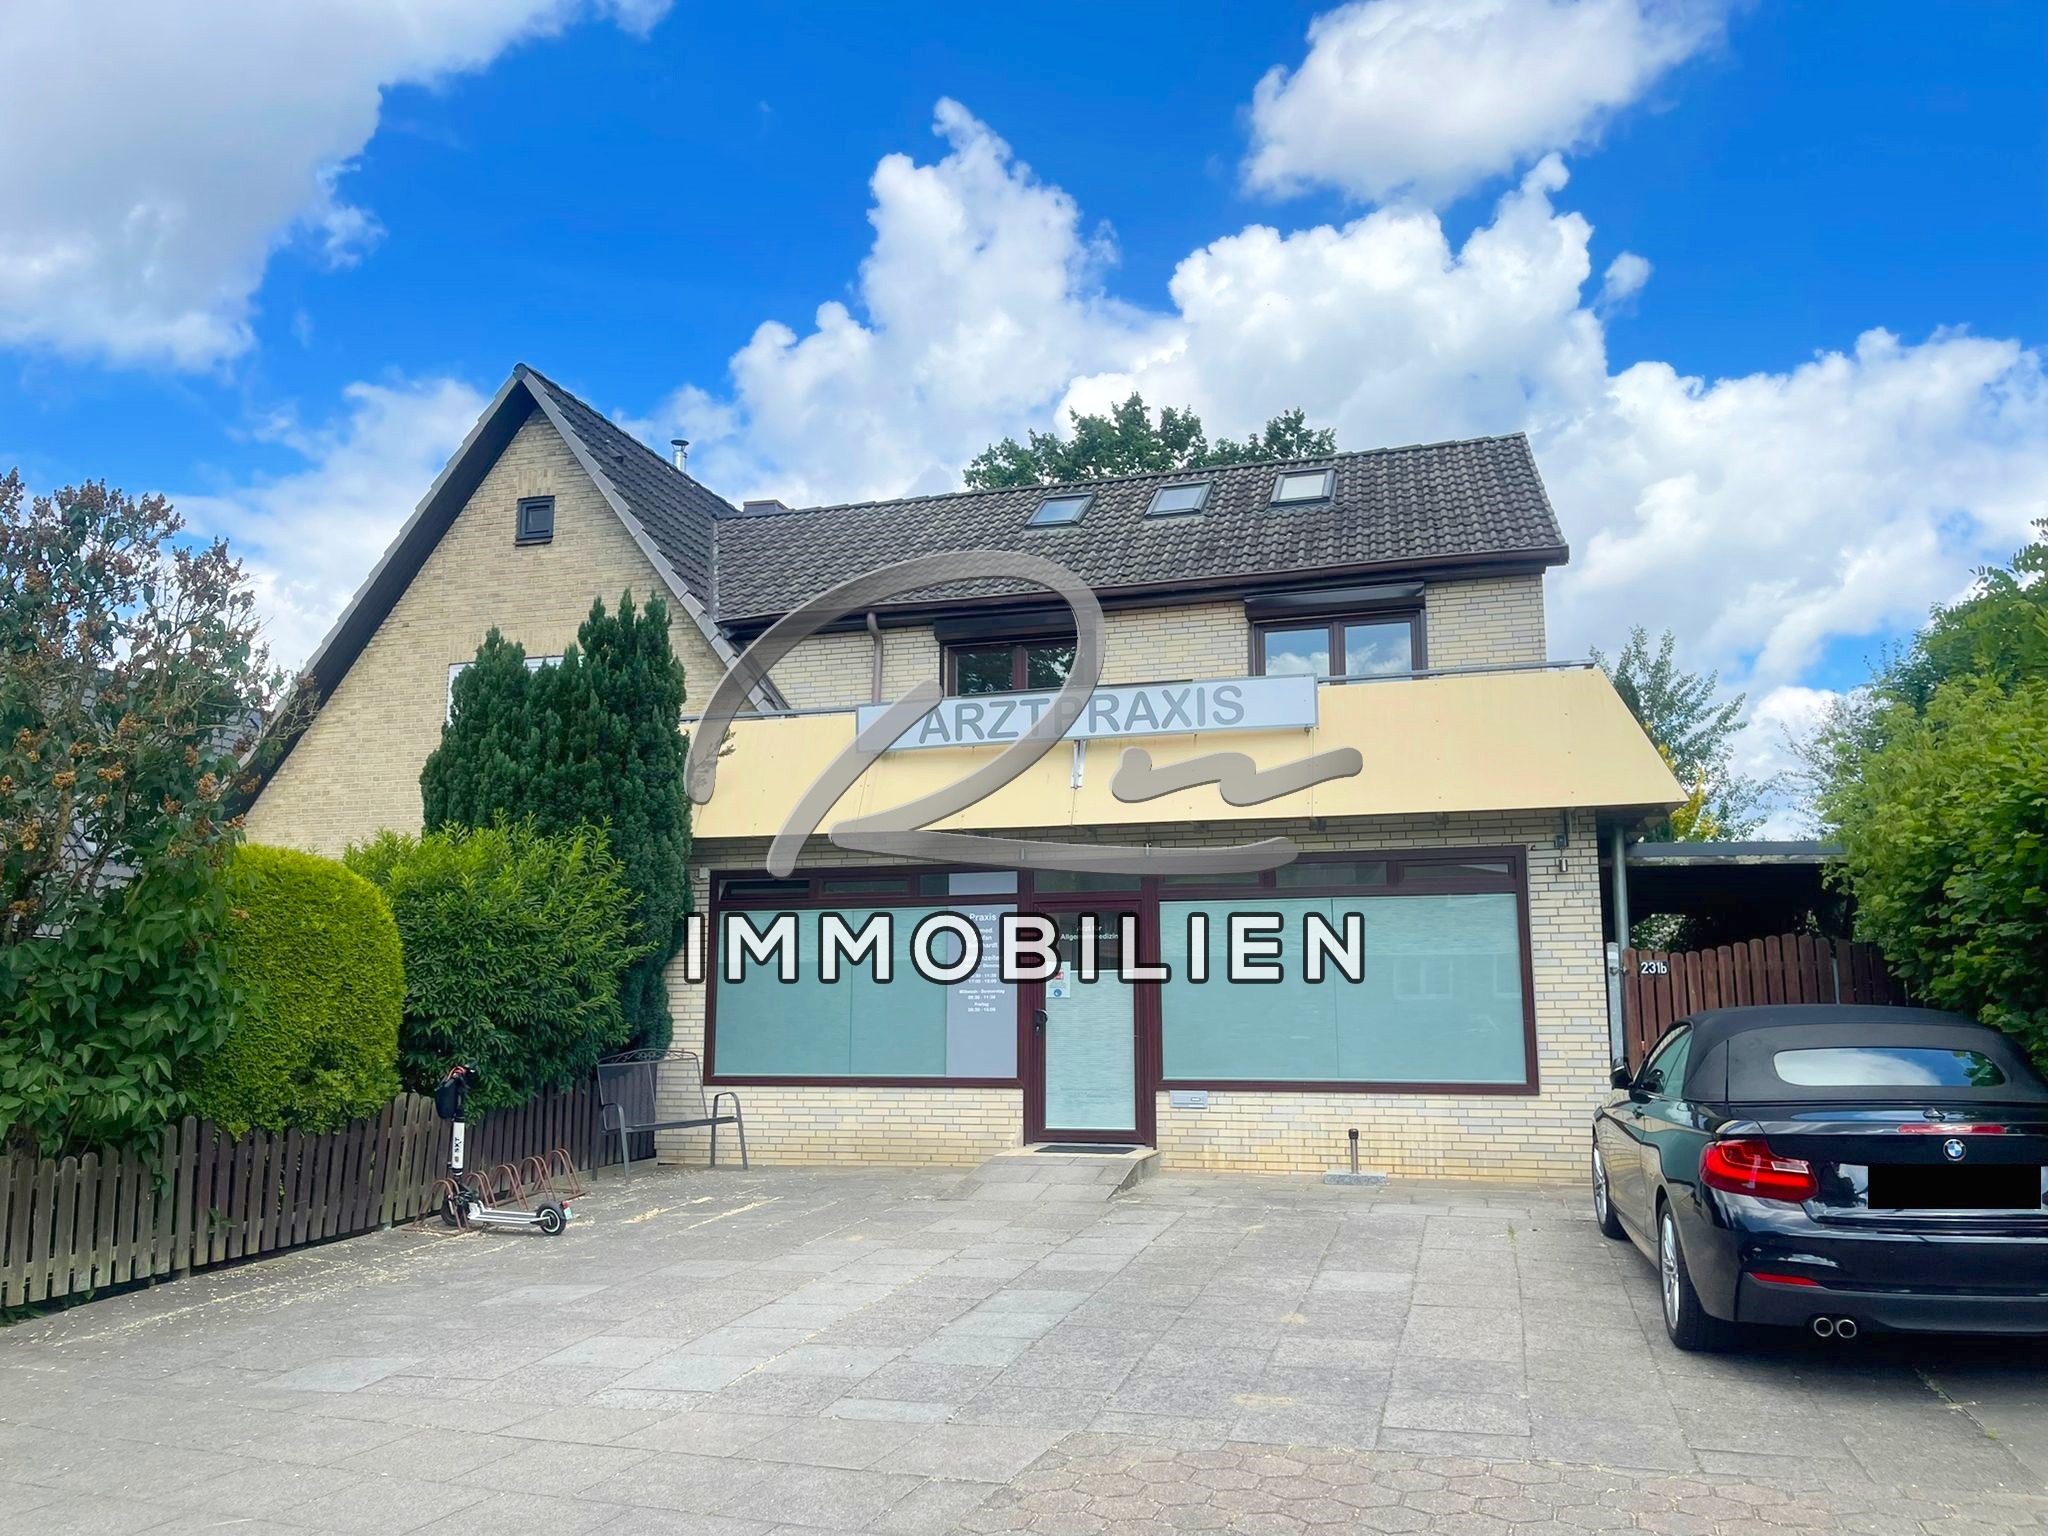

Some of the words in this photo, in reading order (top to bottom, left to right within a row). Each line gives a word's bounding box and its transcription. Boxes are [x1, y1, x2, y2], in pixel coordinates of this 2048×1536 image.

[918, 685, 1245, 745] ARZTPRAXIS
[969, 912, 997, 922] Praxis
[1640, 961, 1668, 974] 231b
